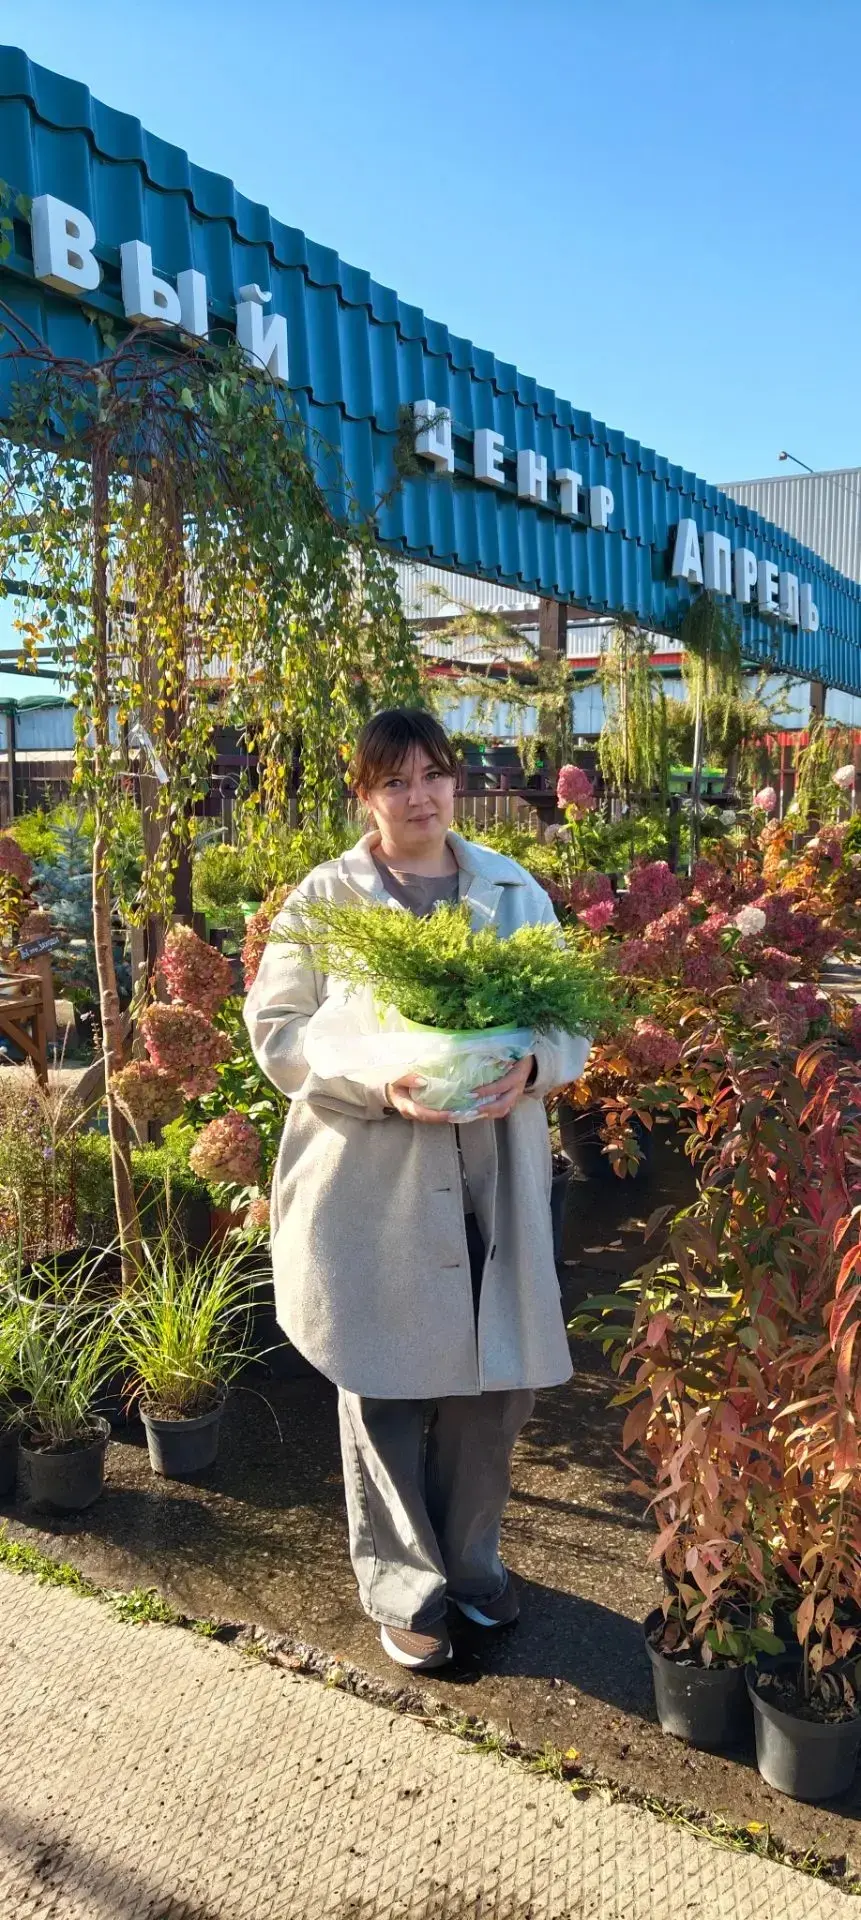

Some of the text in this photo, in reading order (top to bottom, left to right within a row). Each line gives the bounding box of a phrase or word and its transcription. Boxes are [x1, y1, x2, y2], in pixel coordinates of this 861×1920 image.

[32, 194, 819, 632] ВЫЙ ЦЕНТР АПРЕЛЬ
